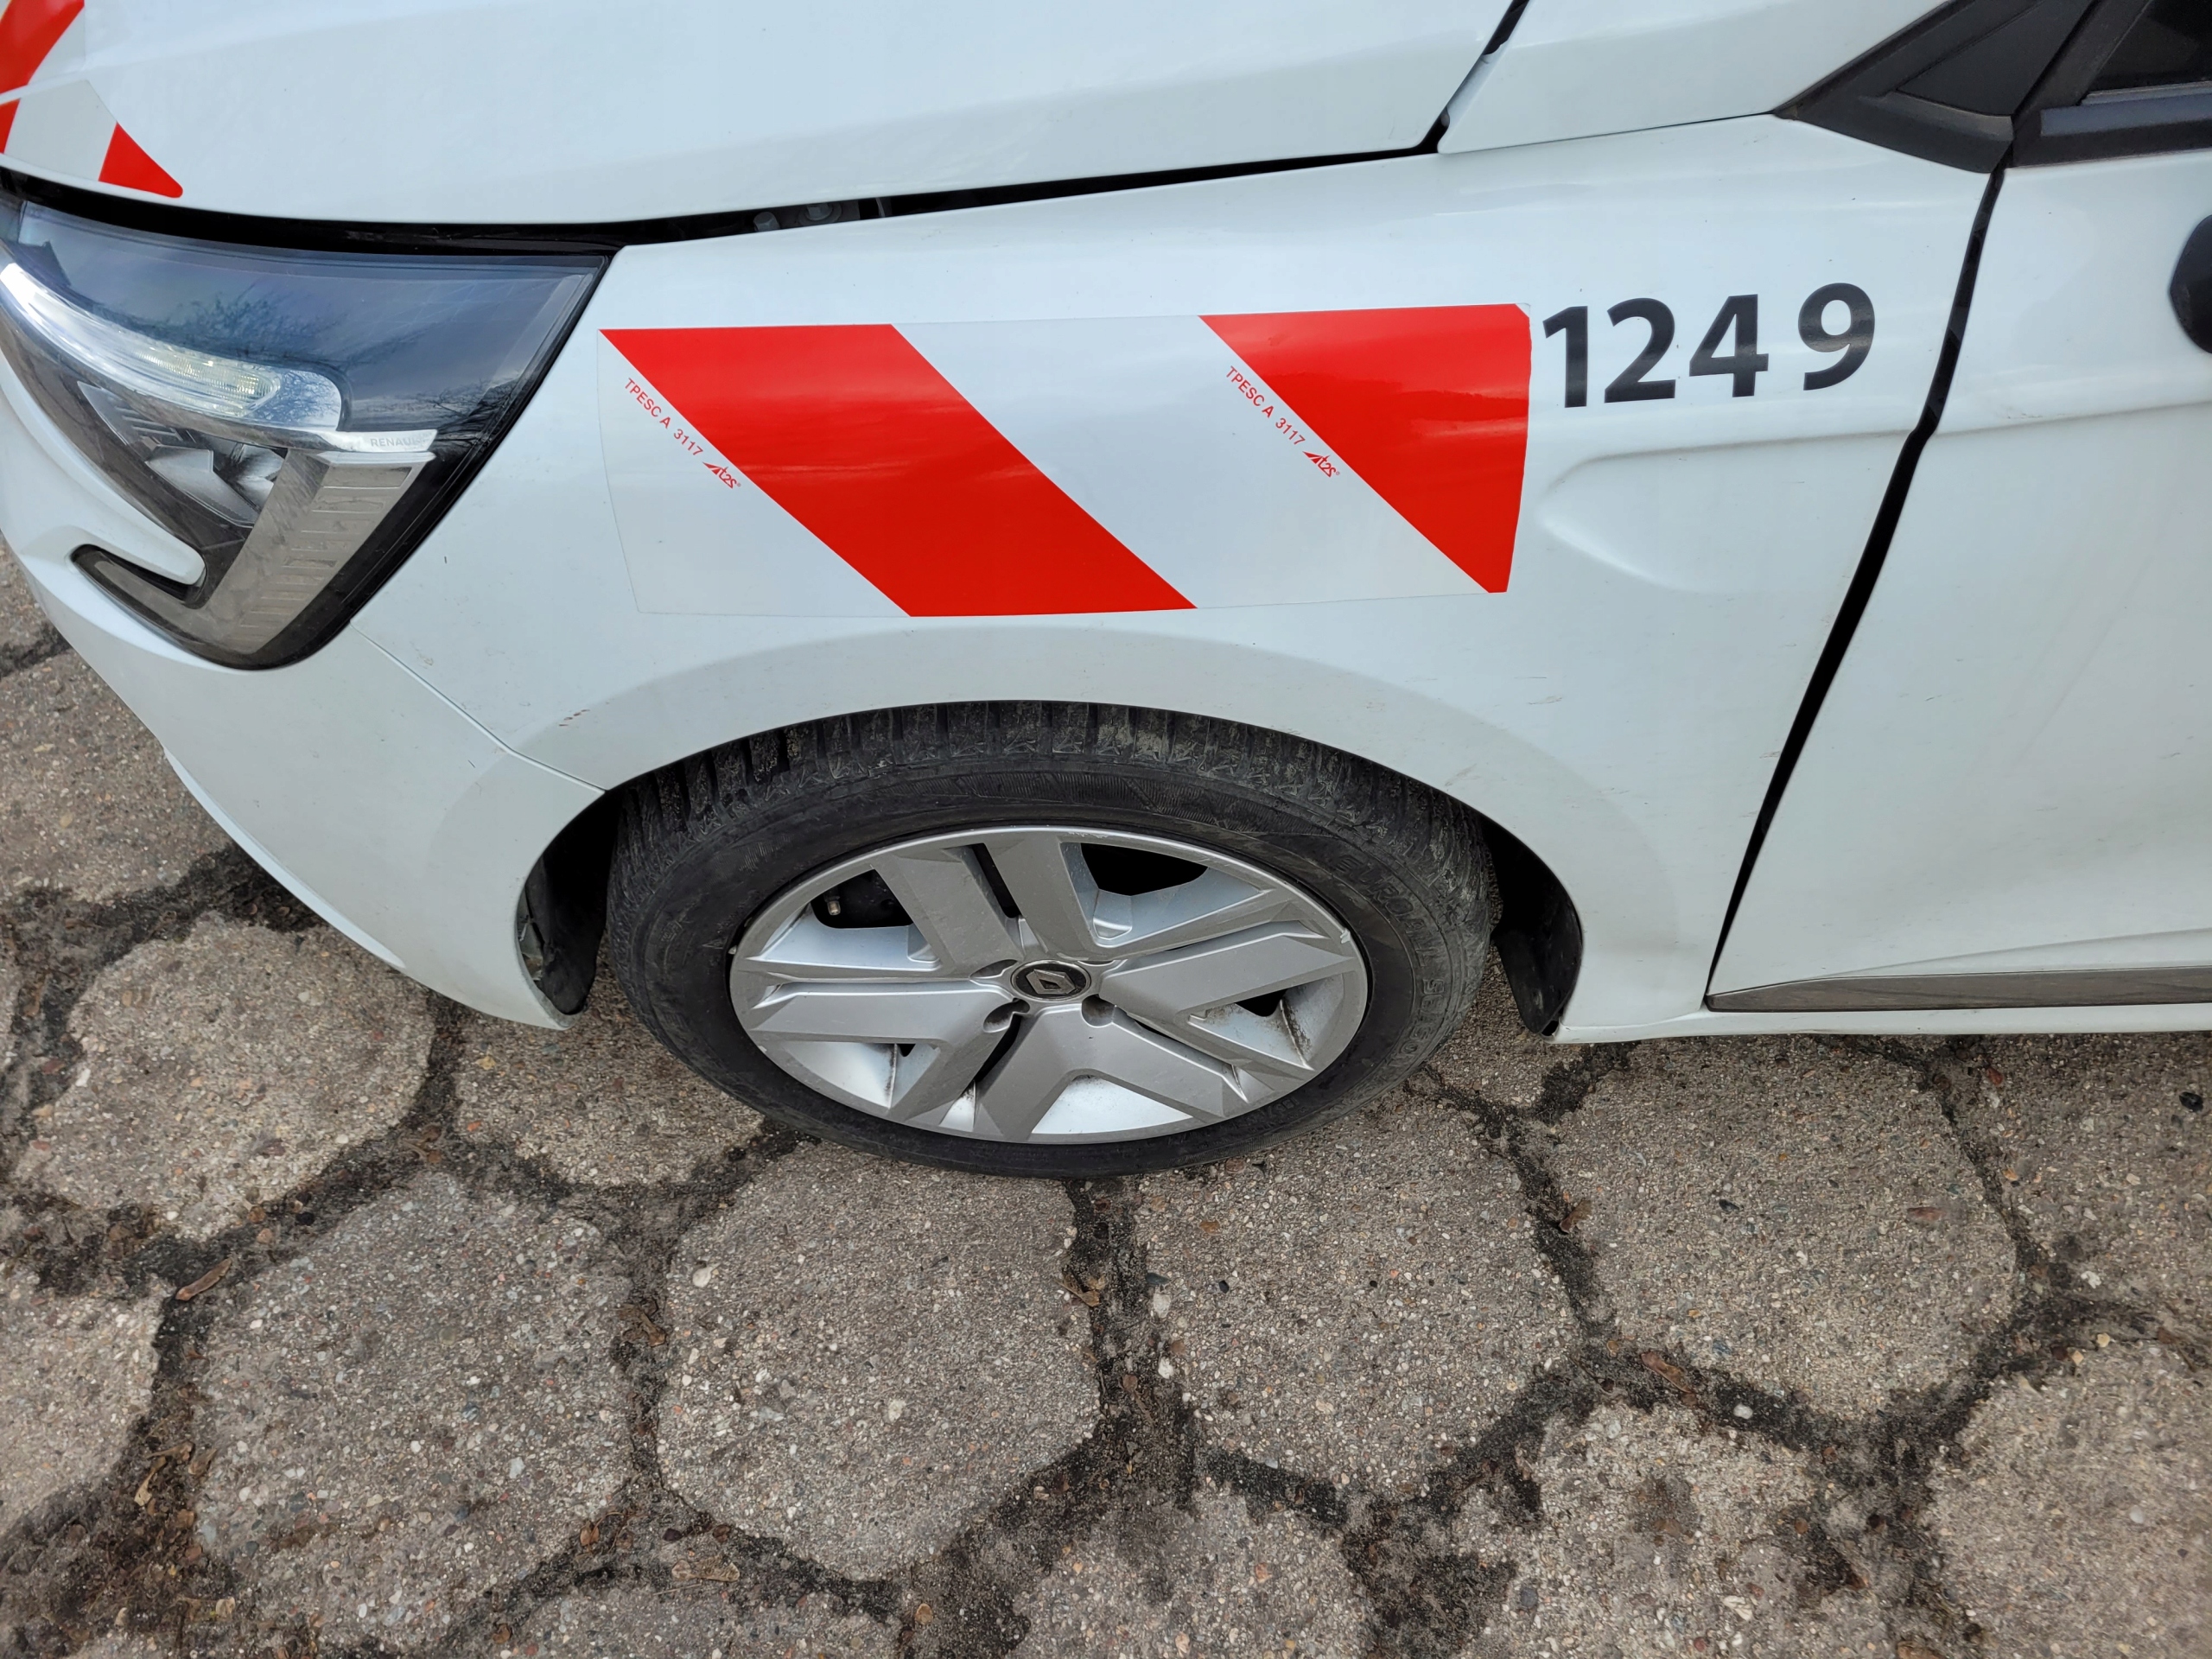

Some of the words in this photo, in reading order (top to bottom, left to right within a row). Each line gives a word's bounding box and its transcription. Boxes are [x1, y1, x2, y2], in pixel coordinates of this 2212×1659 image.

[624, 377, 662, 417] TPESC
[658, 416, 671, 429] A
[673, 429, 704, 456] 3117
[1225, 365, 1265, 407] TPESC
[1262, 405, 1274, 418] A
[1275, 417, 1306, 445] 3117
